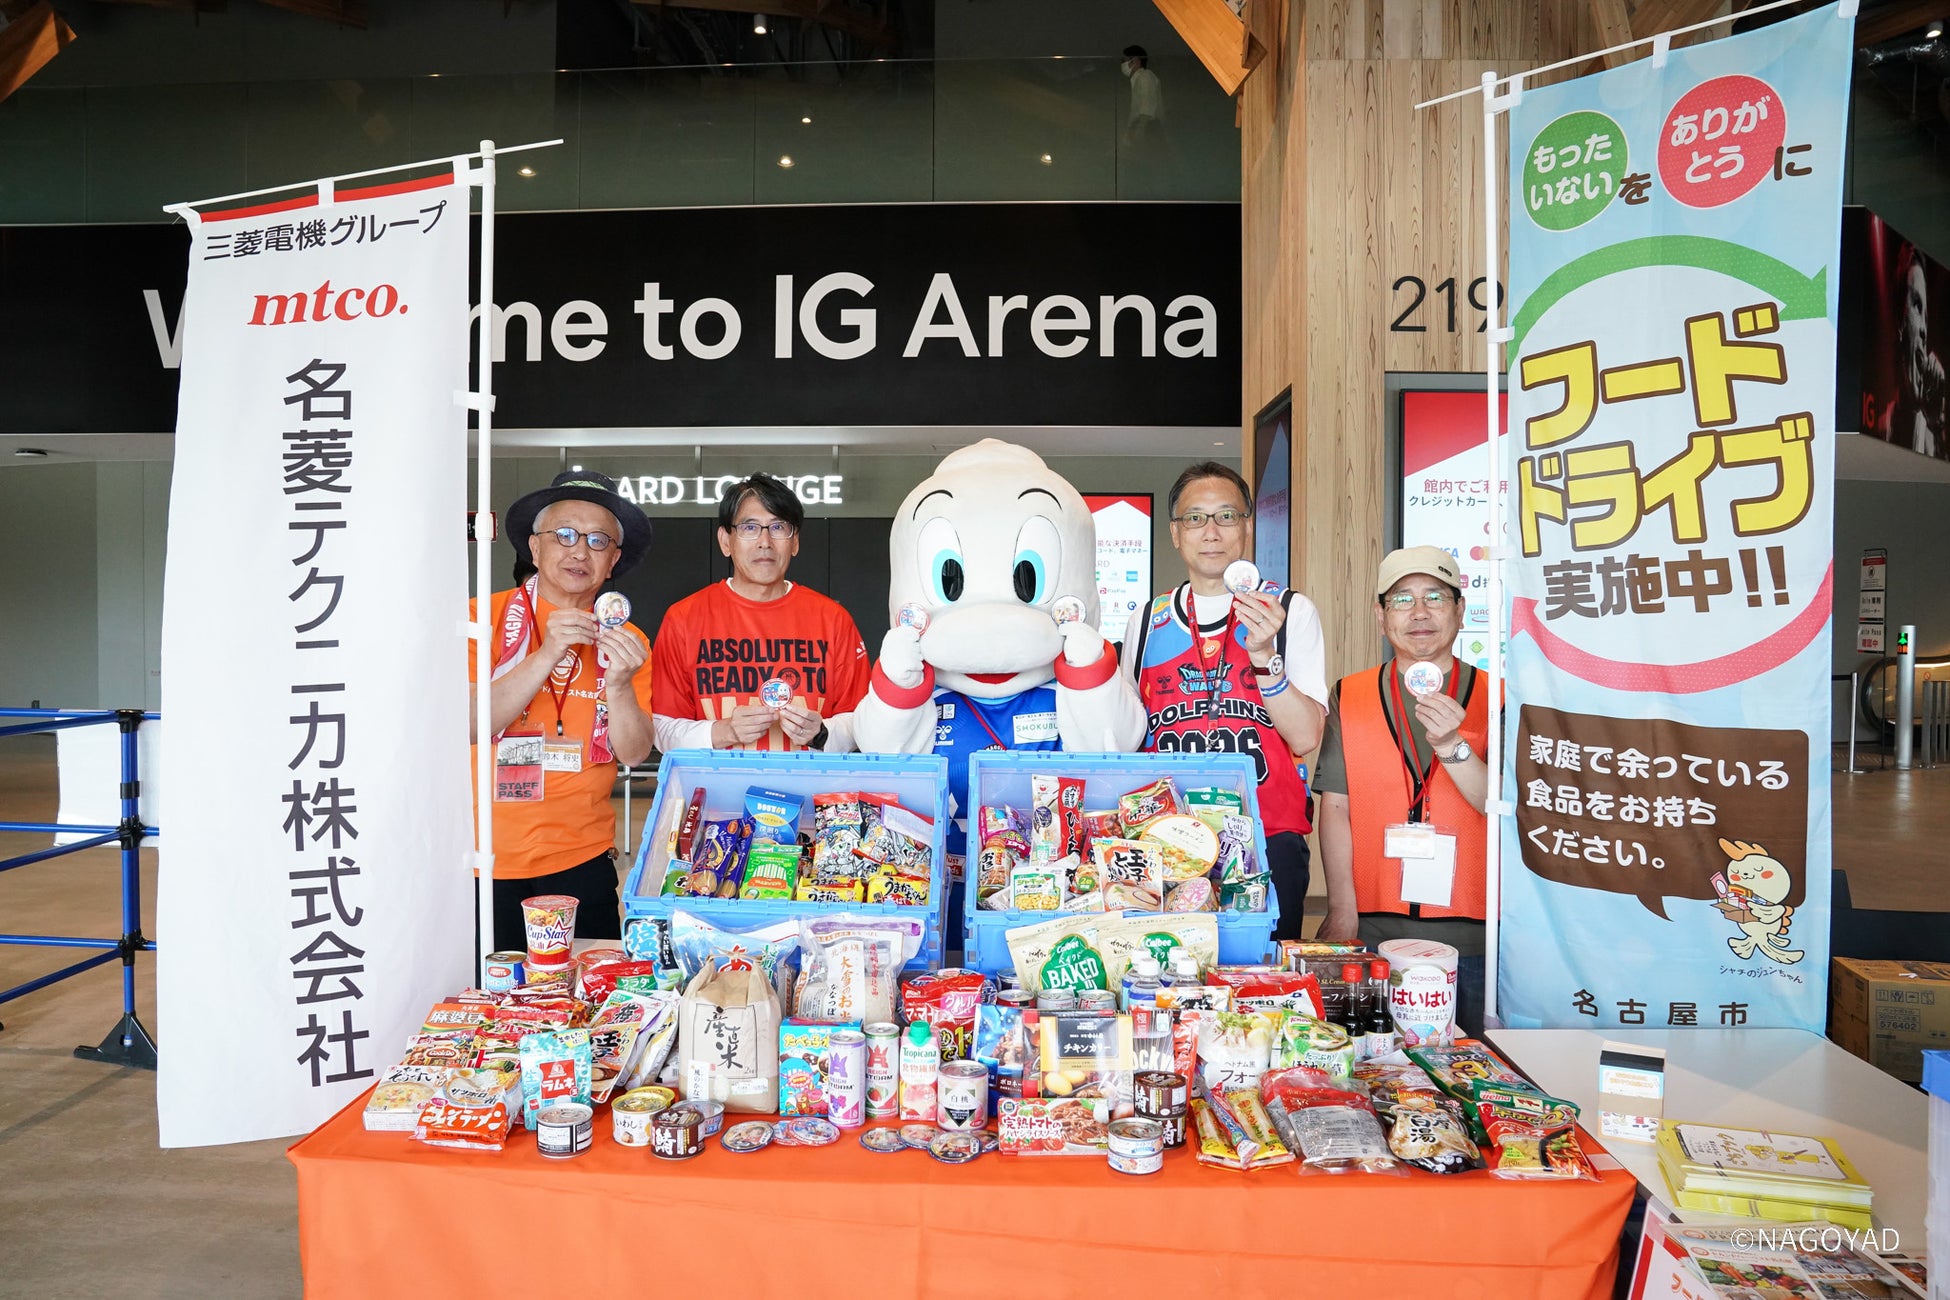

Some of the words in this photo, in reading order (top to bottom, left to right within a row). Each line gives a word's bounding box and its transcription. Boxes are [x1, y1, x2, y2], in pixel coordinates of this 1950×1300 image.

[1671, 95, 1772, 148] ありが
[1533, 132, 1613, 174] もった
[1684, 145, 1745, 185] とう
[1774, 144, 1813, 181] に
[1530, 169, 1613, 211] いない
[1618, 172, 1651, 206] を
[203, 199, 448, 261] 三菱電機グループ
[247, 280, 409, 327] mtco.
[634, 282, 742, 361] to
[775, 271, 878, 361] IG
[902, 272, 1217, 358] Arena
[1520, 302, 1788, 450] フード
[617, 476, 684, 504] ARD
[1409, 495, 1504, 507] クレジットカー、
[1518, 411, 1815, 558] ドライブ
[1543, 545, 1790, 621] 実施中!!
[504, 603, 526, 648] AGOYA
[696, 638, 828, 665] ABSOLUTELY
[696, 665, 774, 695] READY
[803, 666, 827, 694] TO
[281, 358, 375, 1087] 名菱テクニカ株式会社
[1149, 697, 1274, 734] DOLPHINS
[1528, 734, 1790, 791] 家庭で余っている
[498, 782, 539, 790] STAFF
[498, 790, 532, 798] PASS
[1526, 778, 1717, 829] 食品をお持ち
[1527, 825, 1666, 870] ください。
[527, 925, 543, 941] Cup
[543, 926, 566, 941] Star
[1046, 957, 1100, 988] BAKED
[1719, 965, 1804, 984] シャチのジュンちゃん
[826, 983, 838, 1016] ななつぼ
[1391, 987, 1452, 1008] はいはい
[1572, 989, 1749, 1027] 名古屋市
[429, 1010, 484, 1025] 麻婆豆
[904, 1046, 937, 1058] Tropicana
[1064, 1042, 1112, 1054] チキンカリー
[541, 1078, 576, 1092] ラムネ
[1219, 1069, 1257, 1084] フォー
[421, 1104, 503, 1133] みそラーメン
[1003, 1116, 1062, 1130] 完熟トマトの
[1005, 1129, 1061, 1138] ハヤシライスソース
